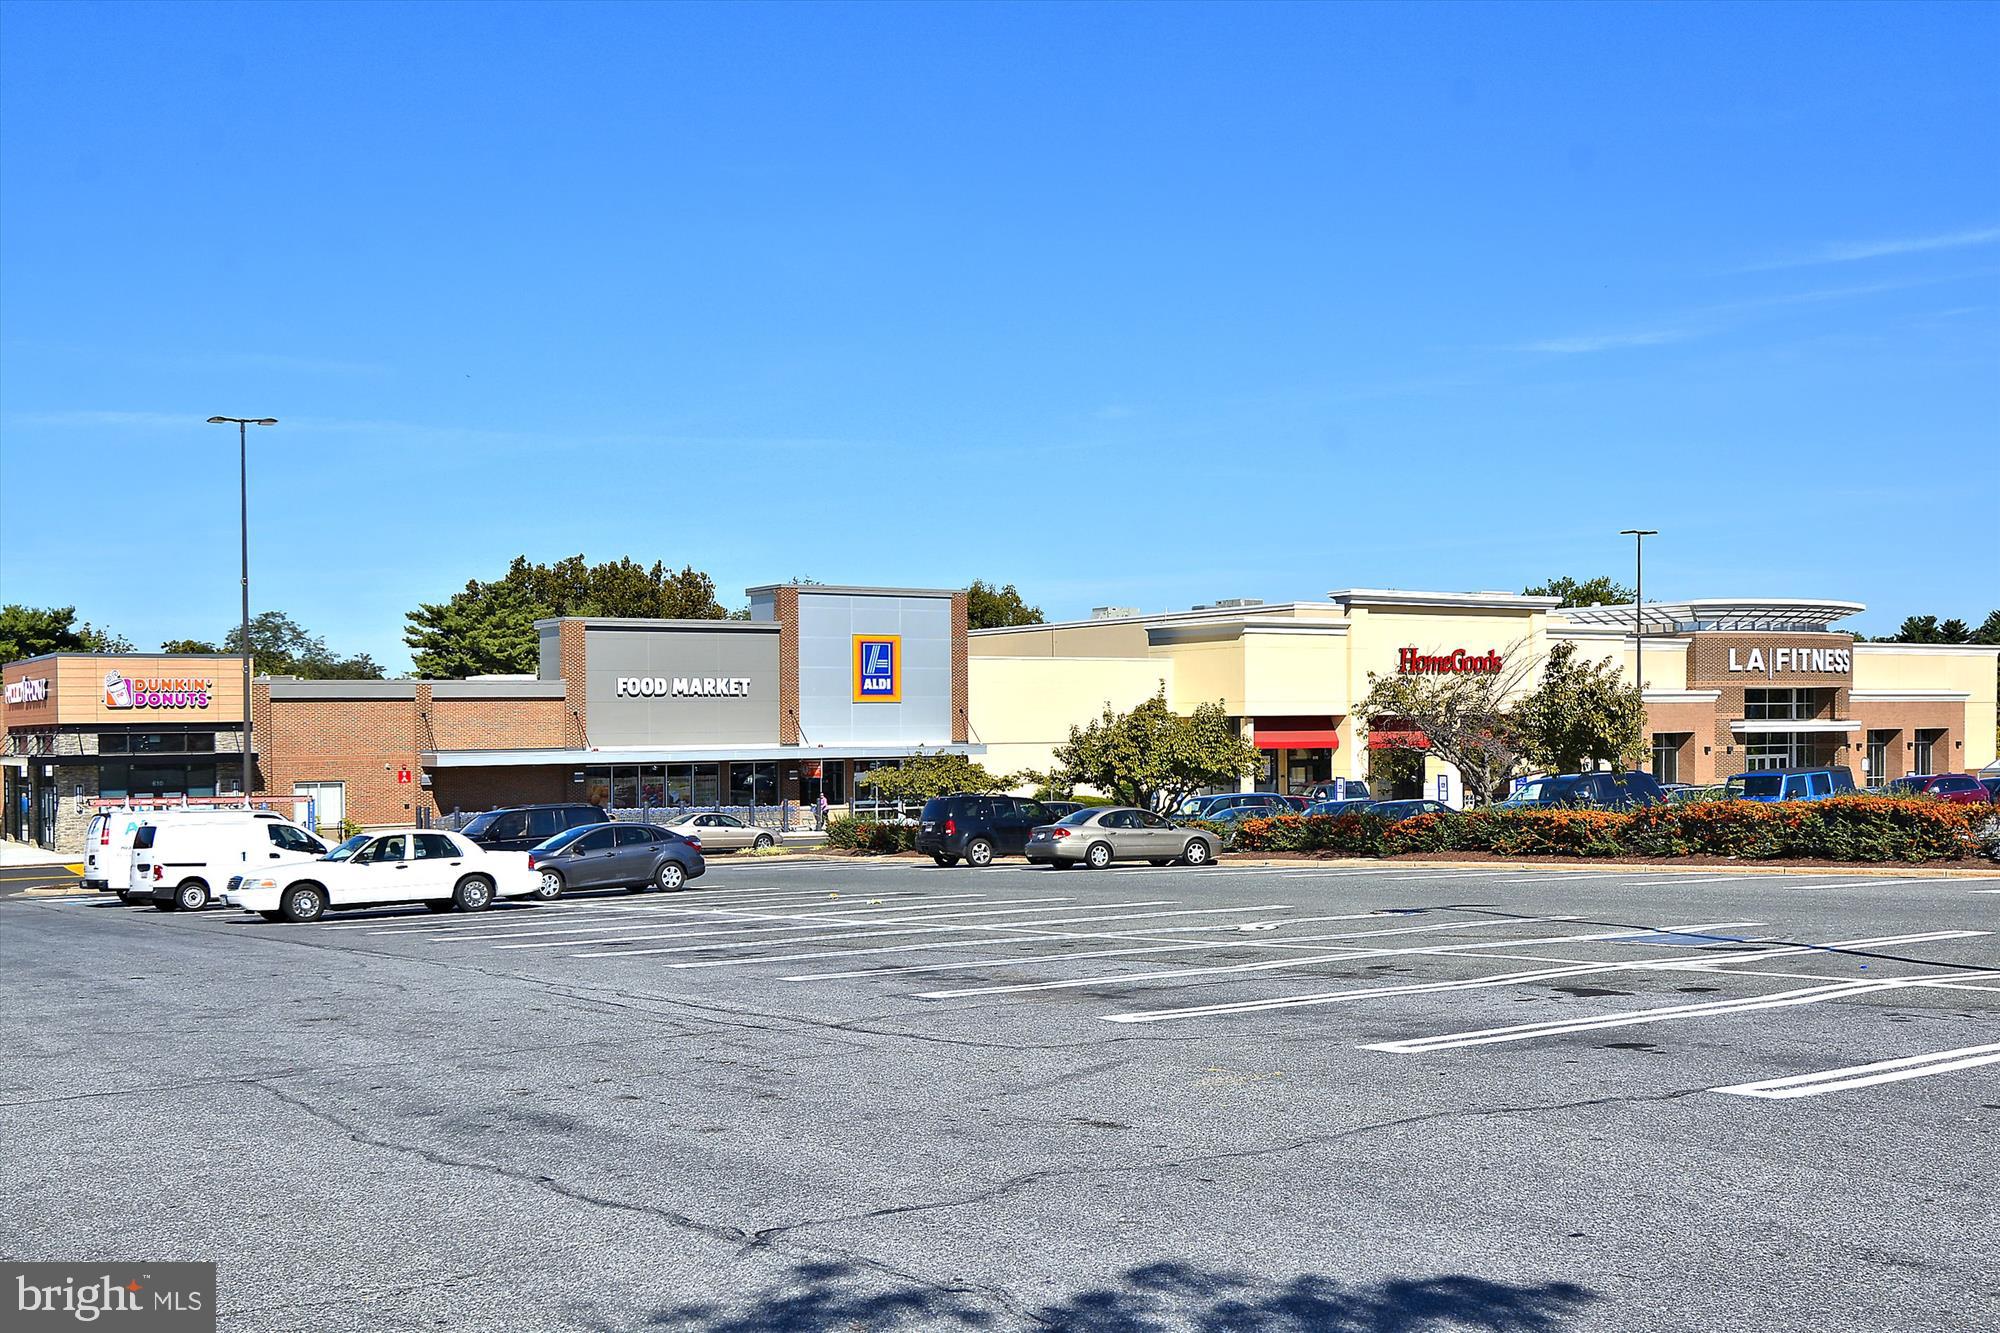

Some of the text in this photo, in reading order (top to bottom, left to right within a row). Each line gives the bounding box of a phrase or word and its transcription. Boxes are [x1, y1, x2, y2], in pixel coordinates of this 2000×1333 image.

[1398, 647, 1502, 675] HomeGoods
[1728, 647, 1850, 674] LA FITNESS
[134, 678, 212, 692] DUNKIN'
[616, 677, 750, 697] FOOD MARKET
[863, 678, 891, 690] ALDI
[134, 693, 208, 706] DONUTS
